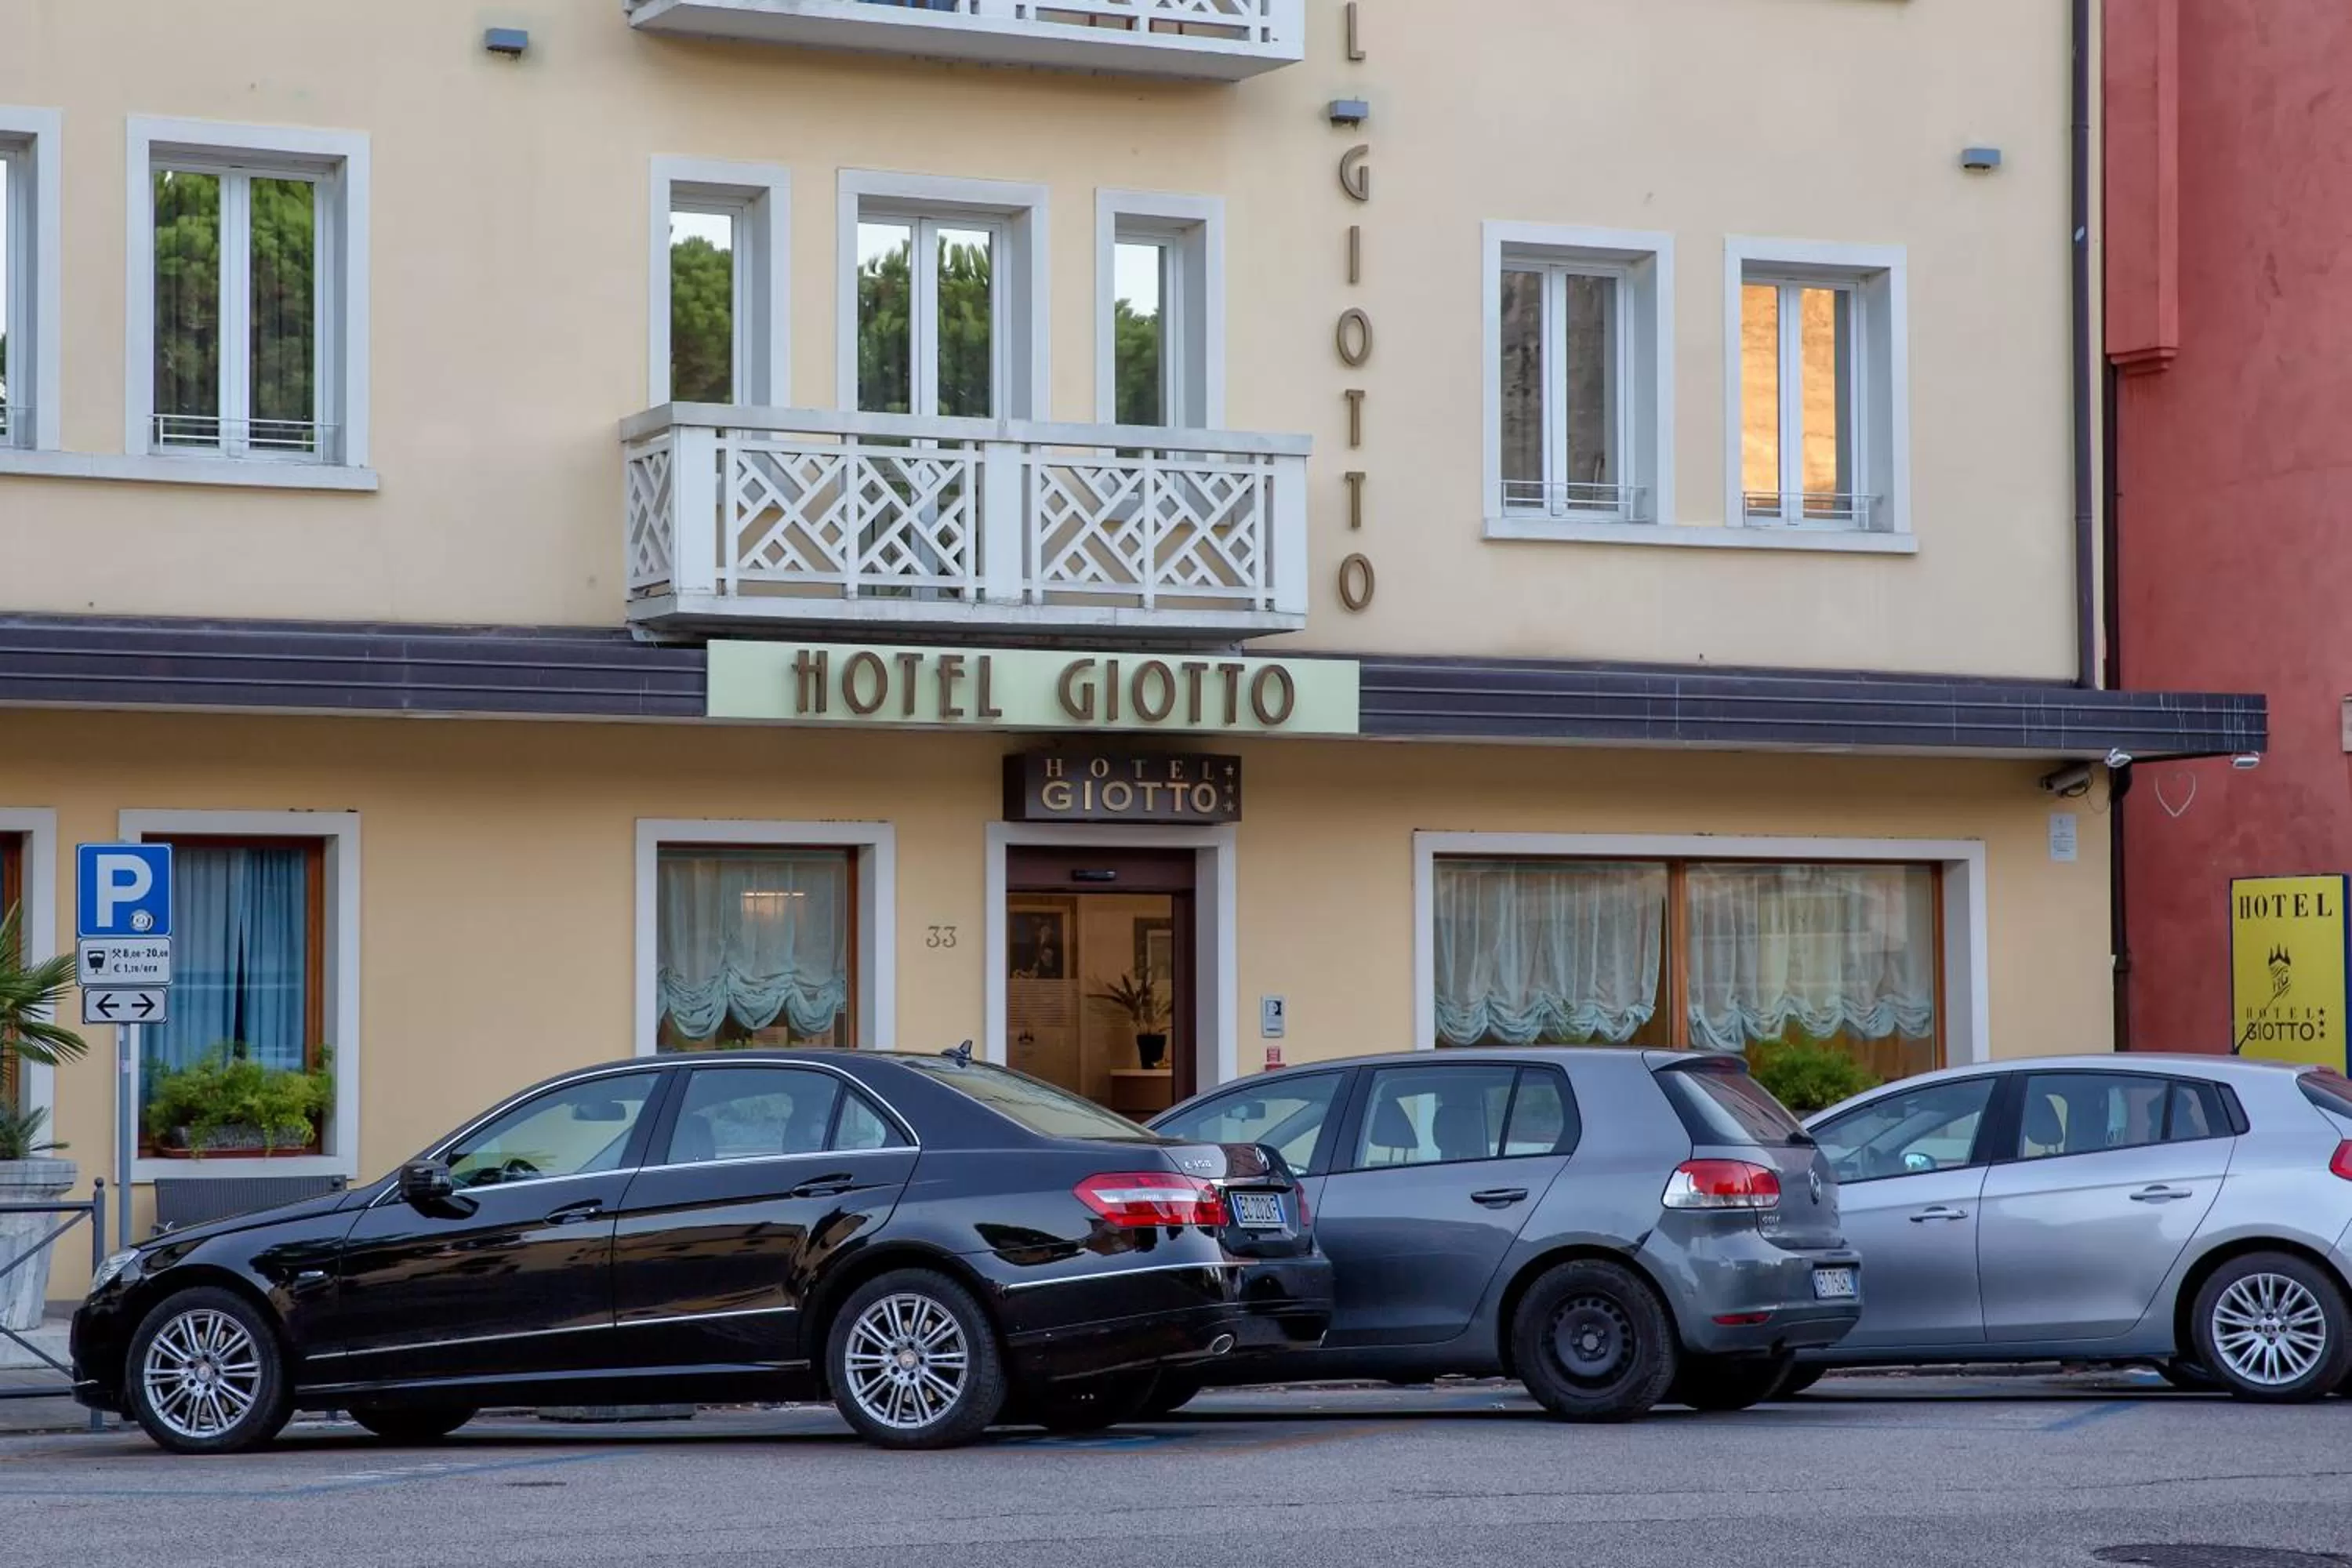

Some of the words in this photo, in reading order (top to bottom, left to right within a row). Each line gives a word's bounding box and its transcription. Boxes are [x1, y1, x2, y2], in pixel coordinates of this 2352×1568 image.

[1337, 144, 1374, 611] GIOTTO
[792, 649, 1003, 718] HOTEL
[1058, 658, 1295, 726] GIOTTO
[1045, 758, 1214, 779] HOTEL
[1042, 780, 1217, 813] GIOTTO
[96, 854, 153, 927] P
[2240, 893, 2332, 919] HOTEL
[926, 926, 956, 949] 33
[2247, 1022, 2315, 1041] GIOTTO
